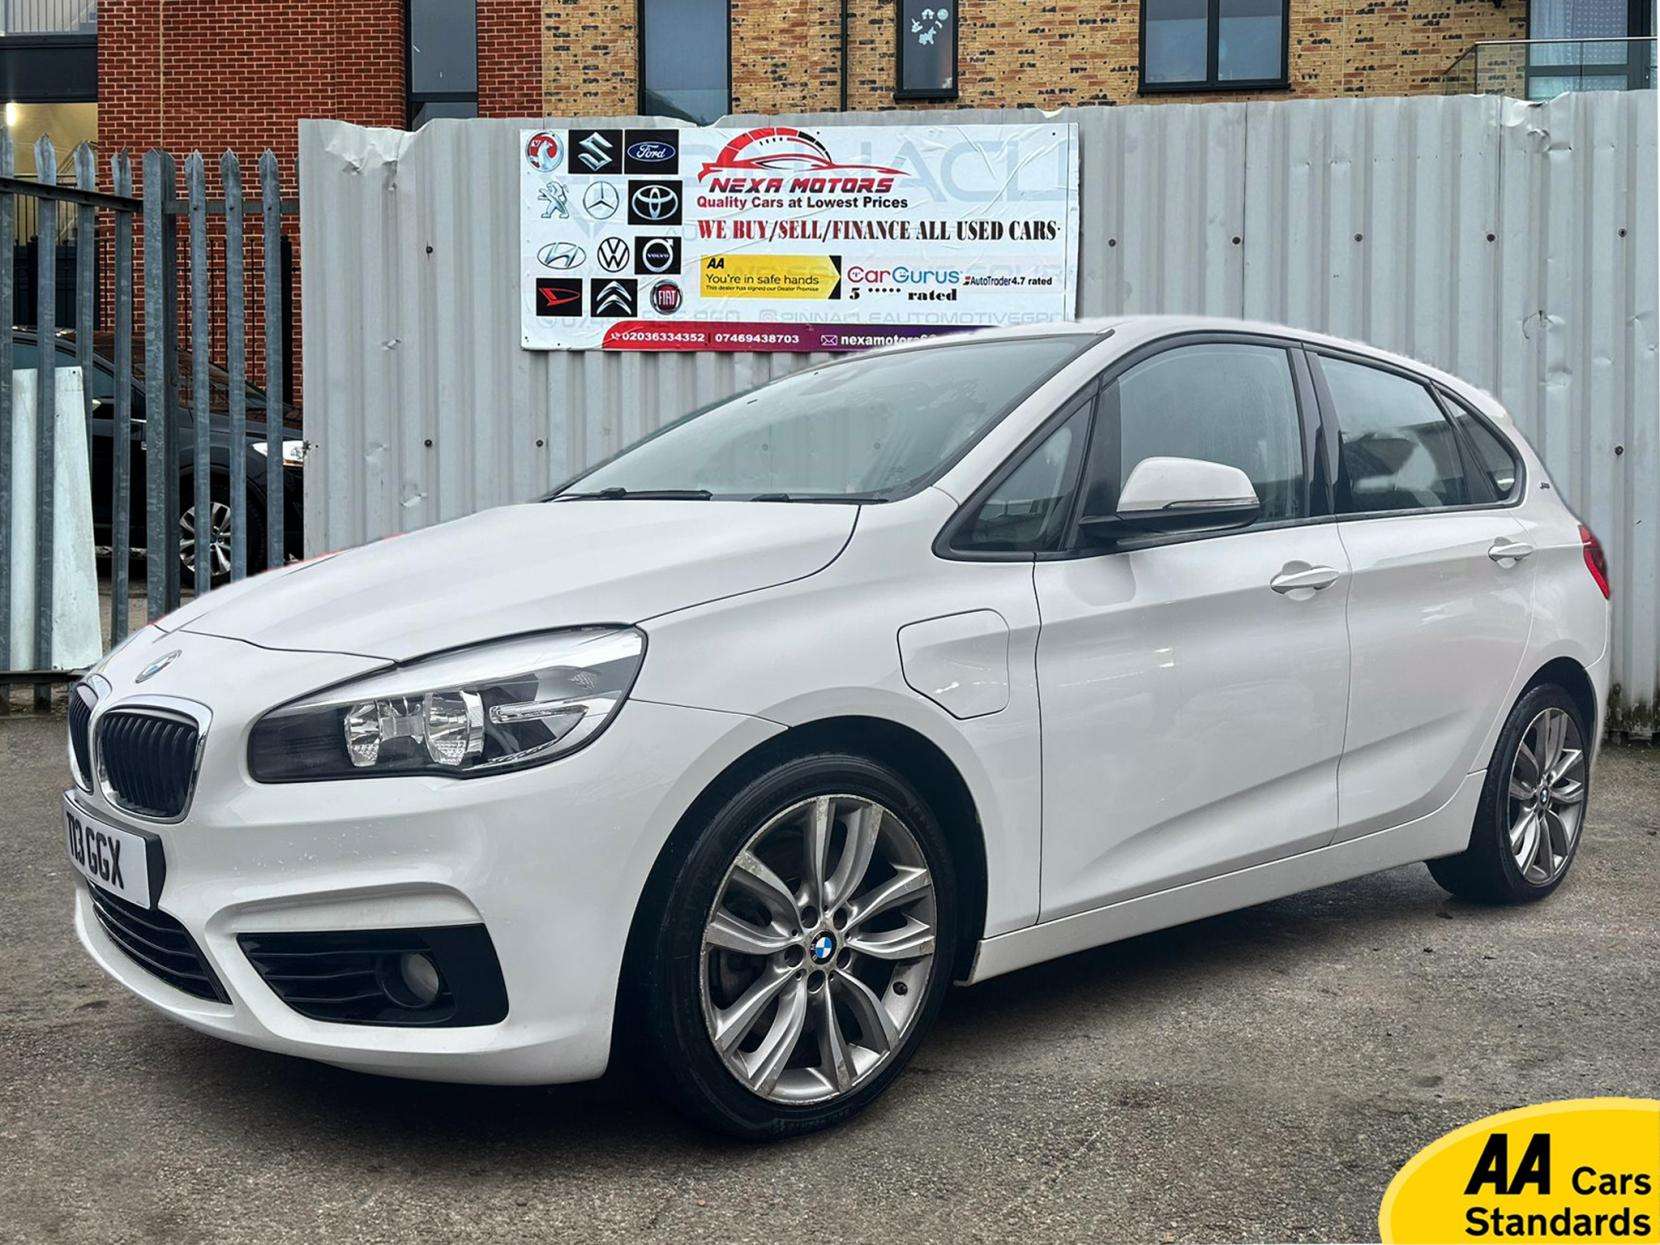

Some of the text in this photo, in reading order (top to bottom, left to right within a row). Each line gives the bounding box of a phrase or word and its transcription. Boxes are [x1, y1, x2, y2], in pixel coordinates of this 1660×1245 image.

[636, 145, 666, 159] Ford
[709, 177, 894, 193] NEXA MOTORS
[697, 196, 908, 209] Quality Cars at Lowest Prices
[697, 220, 727, 240] WE
[733, 220, 911, 242] BUY/SELL/FINANCE
[917, 221, 950, 240] ALL
[957, 221, 1004, 241] USED
[707, 258, 725, 269] AA
[706, 274, 819, 285] You're in safe hands
[847, 266, 959, 284] CarGurus
[1028, 277, 1052, 286] rated
[658, 290, 676, 306] FIAT
[849, 287, 957, 301] 5 rated
[622, 332, 800, 344] 02036334352 07469438703
[85, 826, 124, 890] GGX
